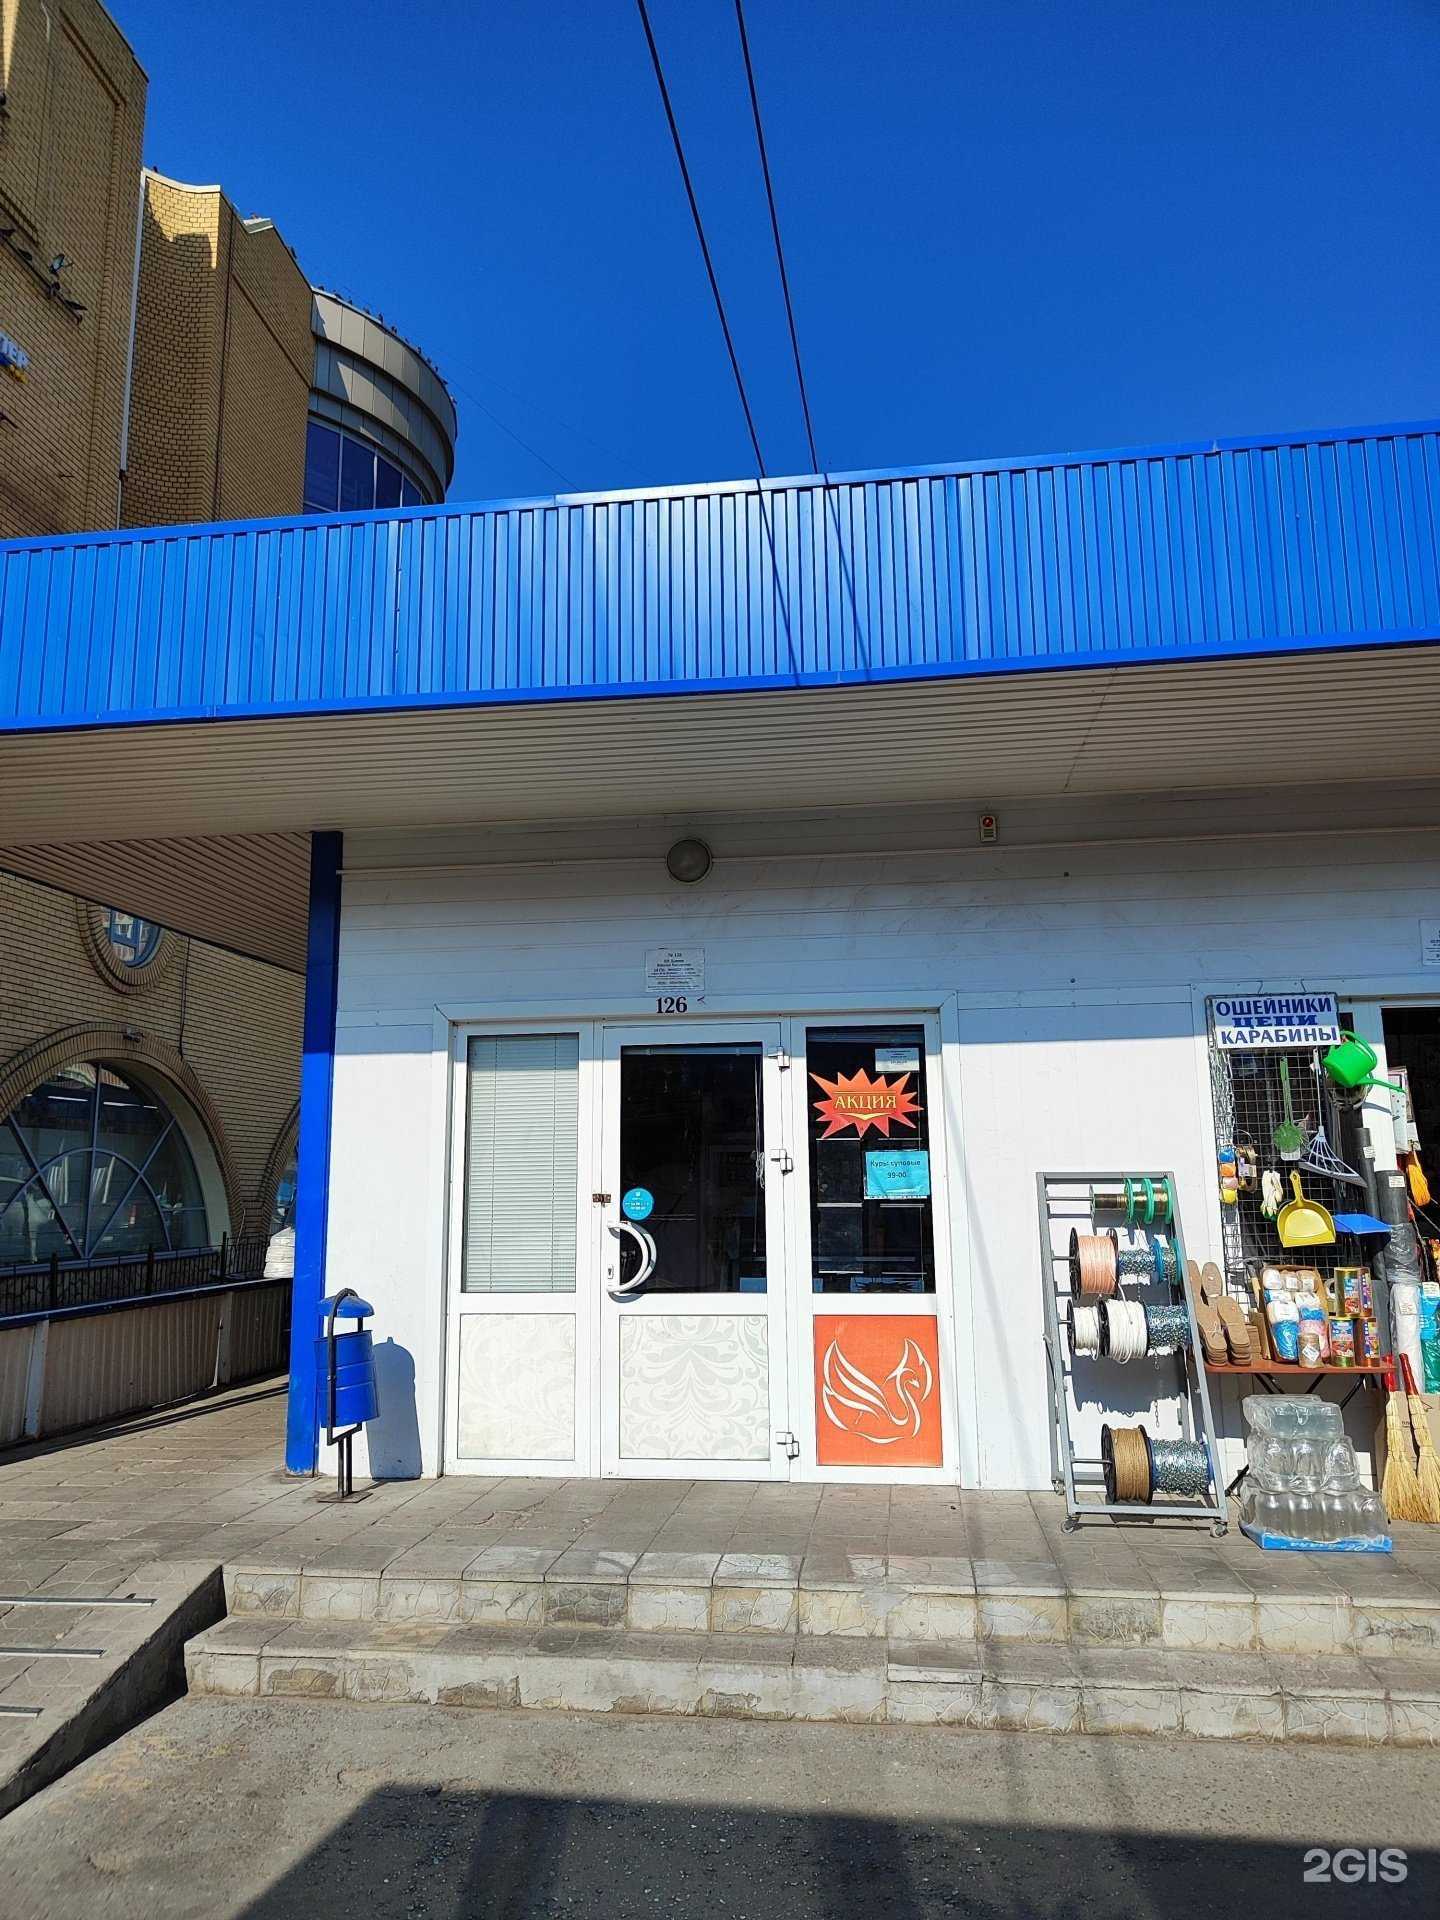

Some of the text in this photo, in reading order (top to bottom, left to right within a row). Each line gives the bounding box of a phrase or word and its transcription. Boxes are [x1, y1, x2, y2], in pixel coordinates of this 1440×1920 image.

[656, 996, 688, 1013] 126
[1216, 997, 1331, 1016] ОШЕЙНИКИ
[1232, 1014, 1318, 1029] ЦЕПИ
[1221, 1027, 1337, 1044] КАРАБИНЫ
[834, 1095, 896, 1109] АКЦИЯ
